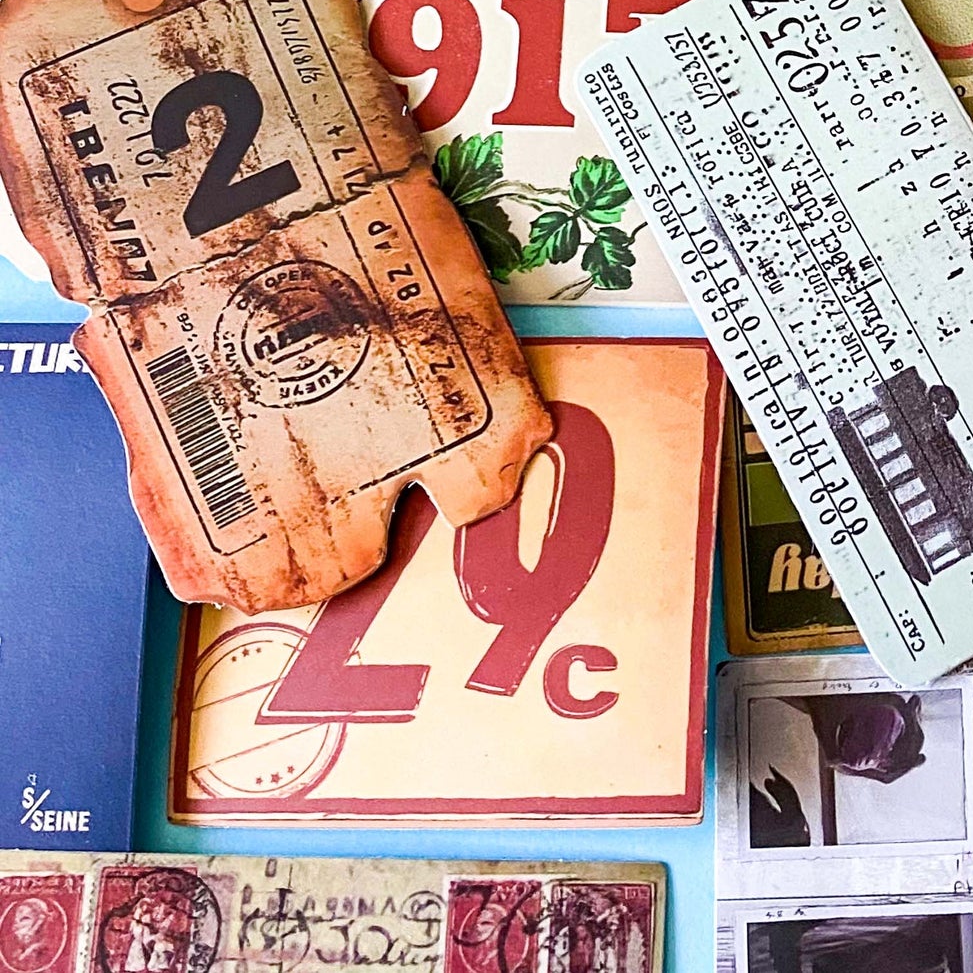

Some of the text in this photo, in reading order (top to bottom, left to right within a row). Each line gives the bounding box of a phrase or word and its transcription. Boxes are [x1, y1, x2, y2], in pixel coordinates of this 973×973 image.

[151, 69, 301, 239] 2
[542, 642, 620, 720] c
[31, 810, 91, 833] SEINE
